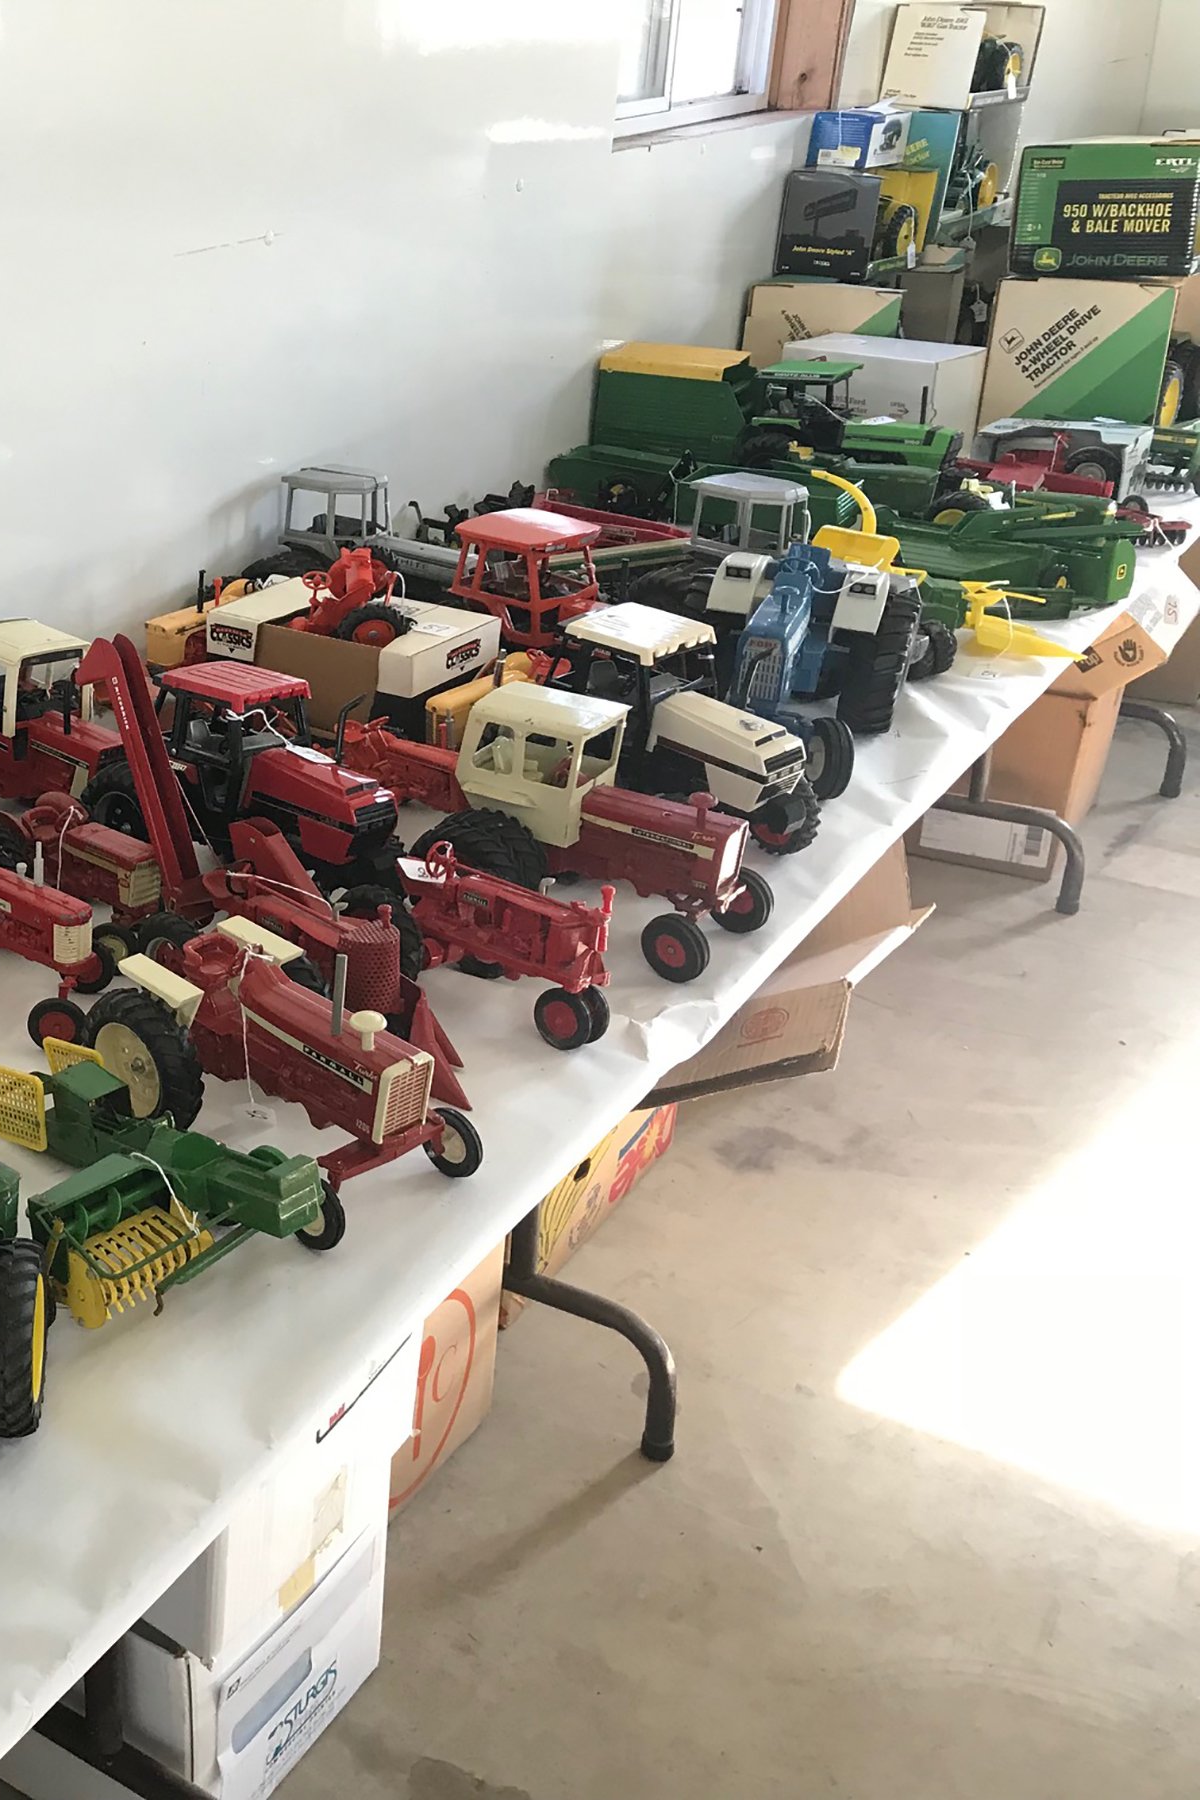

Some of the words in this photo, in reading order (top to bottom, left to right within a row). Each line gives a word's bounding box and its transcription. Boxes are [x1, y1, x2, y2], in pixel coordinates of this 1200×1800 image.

[1155, 157, 1197, 167] ERTL
[1063, 204, 1088, 218] 950
[1092, 203, 1173, 218] W/BACKHOE
[1071, 219, 1081, 233] &
[1086, 219, 1118, 233] BALE
[1123, 219, 1170, 233] MOVER
[1066, 254, 1110, 266] JOHN
[1112, 254, 1169, 266] DEERE
[1014, 337, 1044, 366] JOHN
[1042, 308, 1079, 341] DEERE
[1021, 334, 1069, 374] 4-WHEEL
[1067, 304, 1101, 336] DRIVE
[1025, 340, 1077, 382] TRACTOR
[303, 1046, 364, 1084] FARMALL
